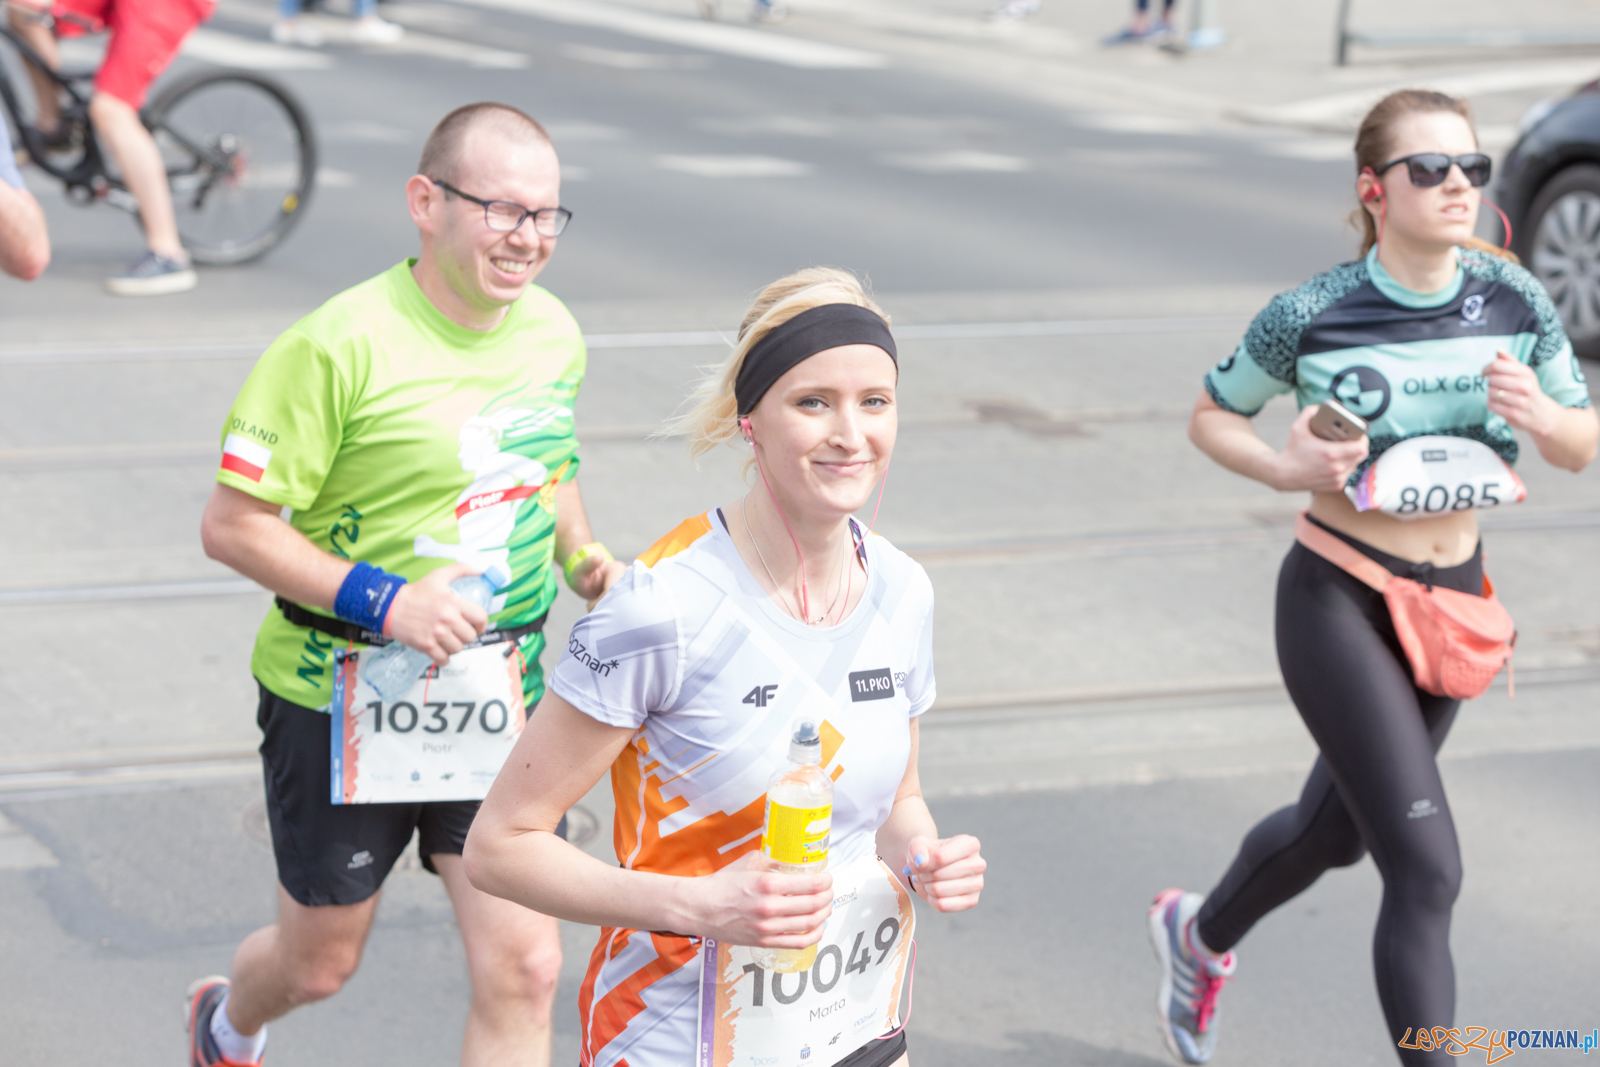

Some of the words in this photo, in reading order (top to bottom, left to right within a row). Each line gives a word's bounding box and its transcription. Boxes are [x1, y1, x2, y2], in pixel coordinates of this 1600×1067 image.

[1403, 376, 1447, 395] OLX
[1455, 374, 1489, 392] GR
[231, 417, 279, 445] OLAND
[1396, 483, 1499, 513] 8085
[742, 684, 779, 708] 4F
[366, 699, 509, 734] 10370
[422, 742, 453, 754] Piotr
[742, 917, 900, 1006] 10049
[809, 998, 846, 1022] Marta
